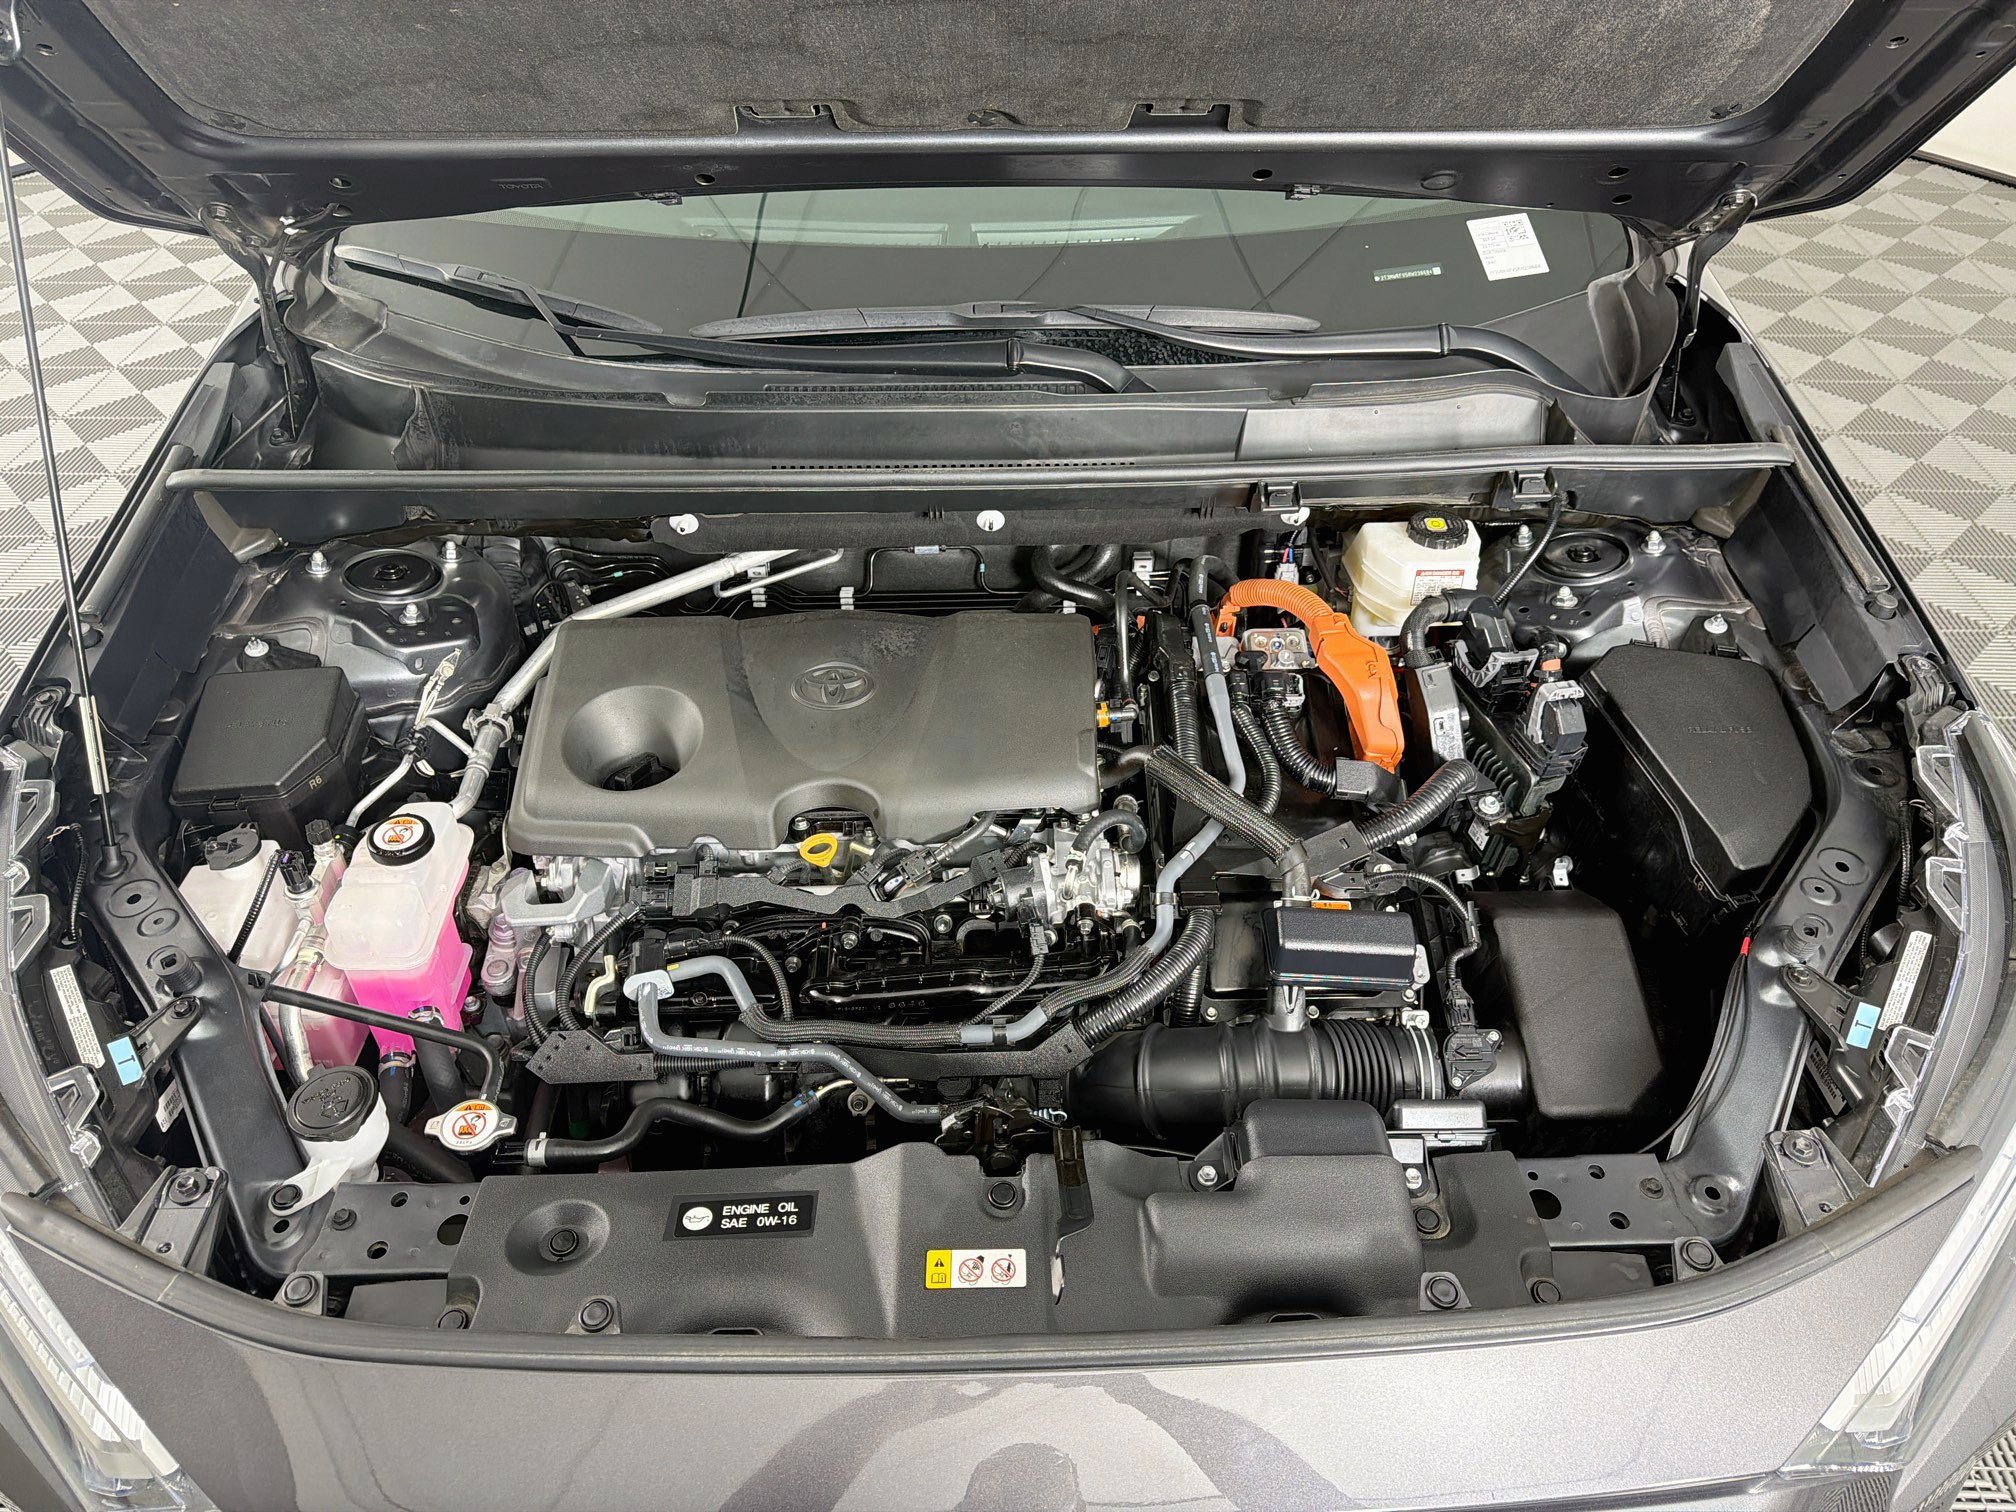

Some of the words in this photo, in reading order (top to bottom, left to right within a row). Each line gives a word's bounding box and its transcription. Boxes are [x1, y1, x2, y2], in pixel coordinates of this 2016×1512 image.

[308, 775, 323, 790] R6
[1855, 1020, 1873, 1030] T
[118, 1055, 136, 1066] T
[722, 1203, 770, 1216] ENGINE
[777, 1202, 799, 1213] OIL
[720, 1217, 748, 1229] SAE
[756, 1214, 797, 1227] 0W-16
